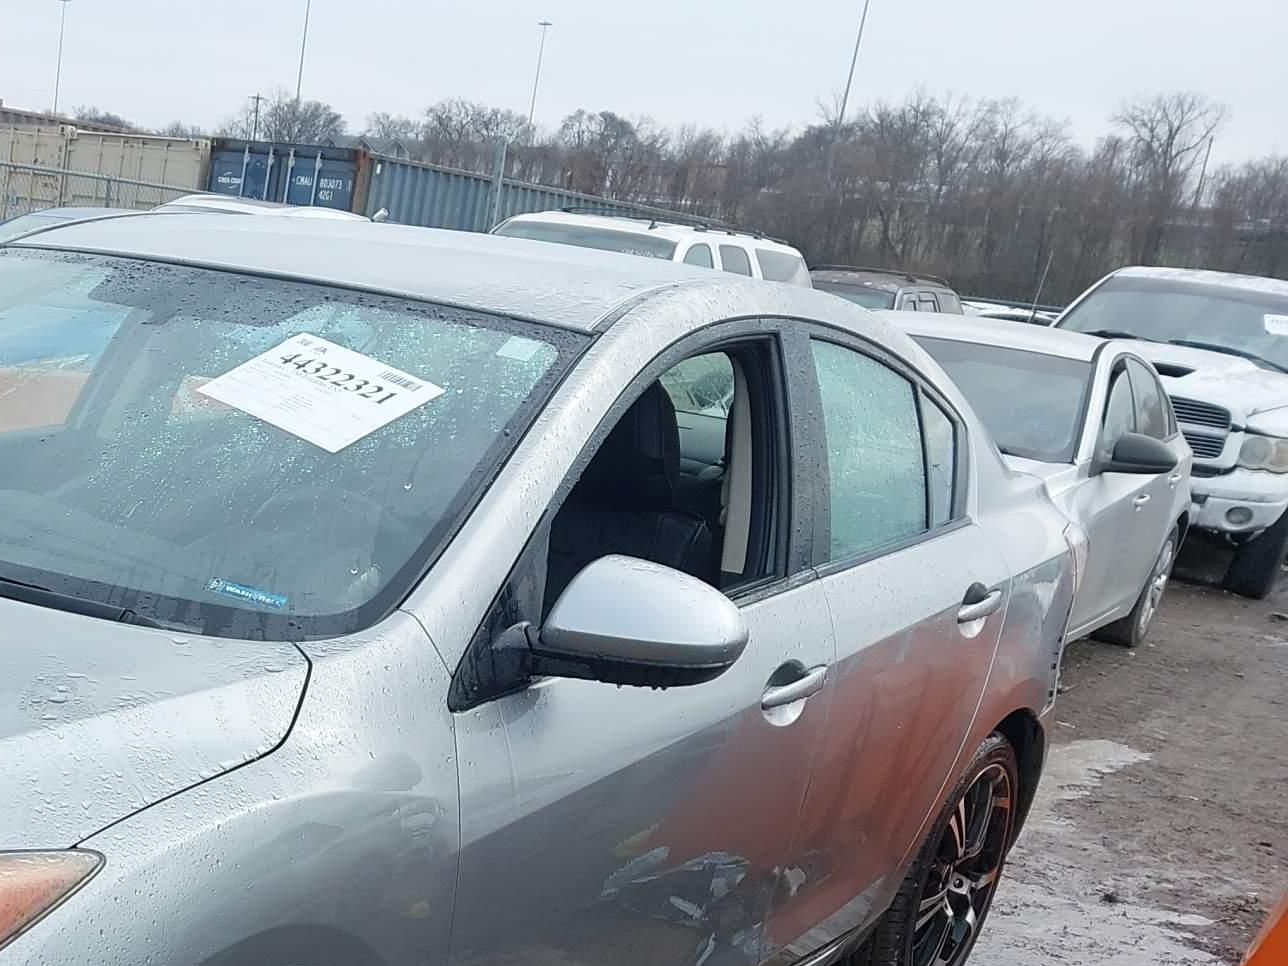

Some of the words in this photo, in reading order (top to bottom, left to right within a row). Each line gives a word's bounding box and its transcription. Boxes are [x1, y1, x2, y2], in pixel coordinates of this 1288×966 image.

[295, 175, 313, 186] CMAU
[319, 178, 343, 190] 803073
[279, 352, 399, 405] 44322321
